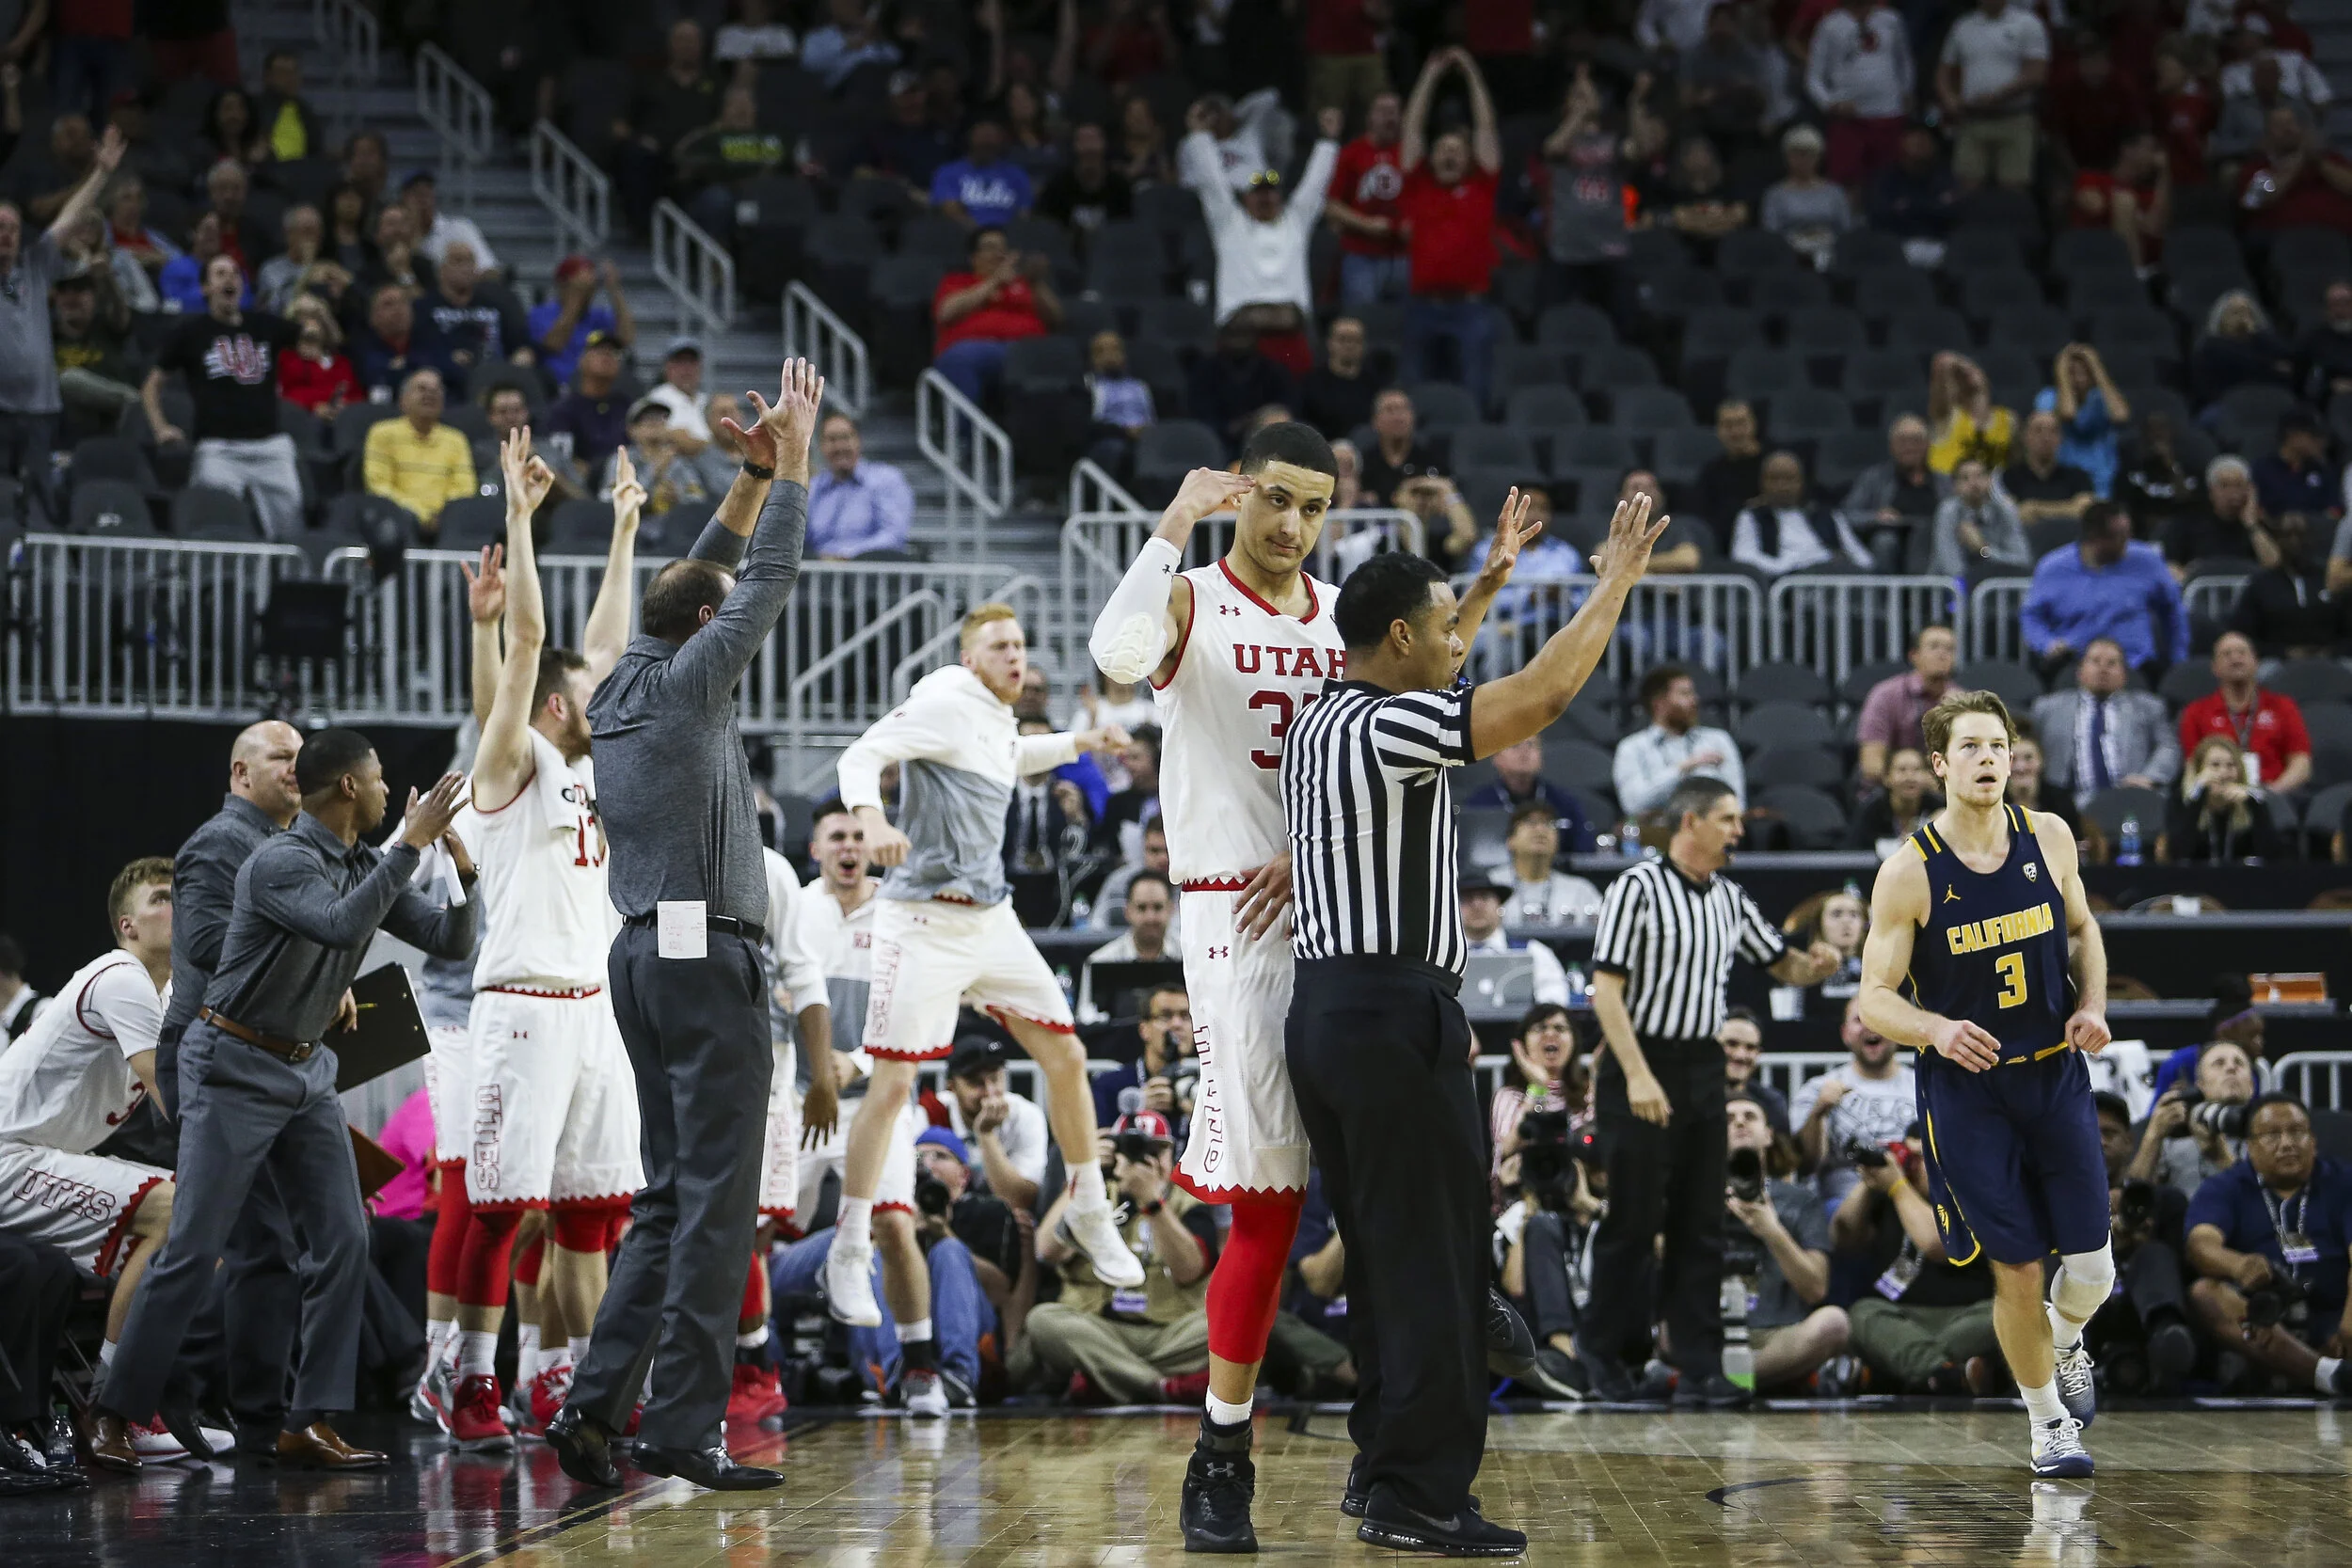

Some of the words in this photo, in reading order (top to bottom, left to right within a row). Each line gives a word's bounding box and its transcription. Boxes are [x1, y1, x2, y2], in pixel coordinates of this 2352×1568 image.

[1232, 643, 1347, 680] UTAH
[1248, 689, 1319, 769] 3
[1947, 902, 2054, 955] CALIFORNIA
[1995, 952, 2027, 1009] 3
[473, 1084, 503, 1192] UTES
[13, 1167, 117, 1223] UTES
